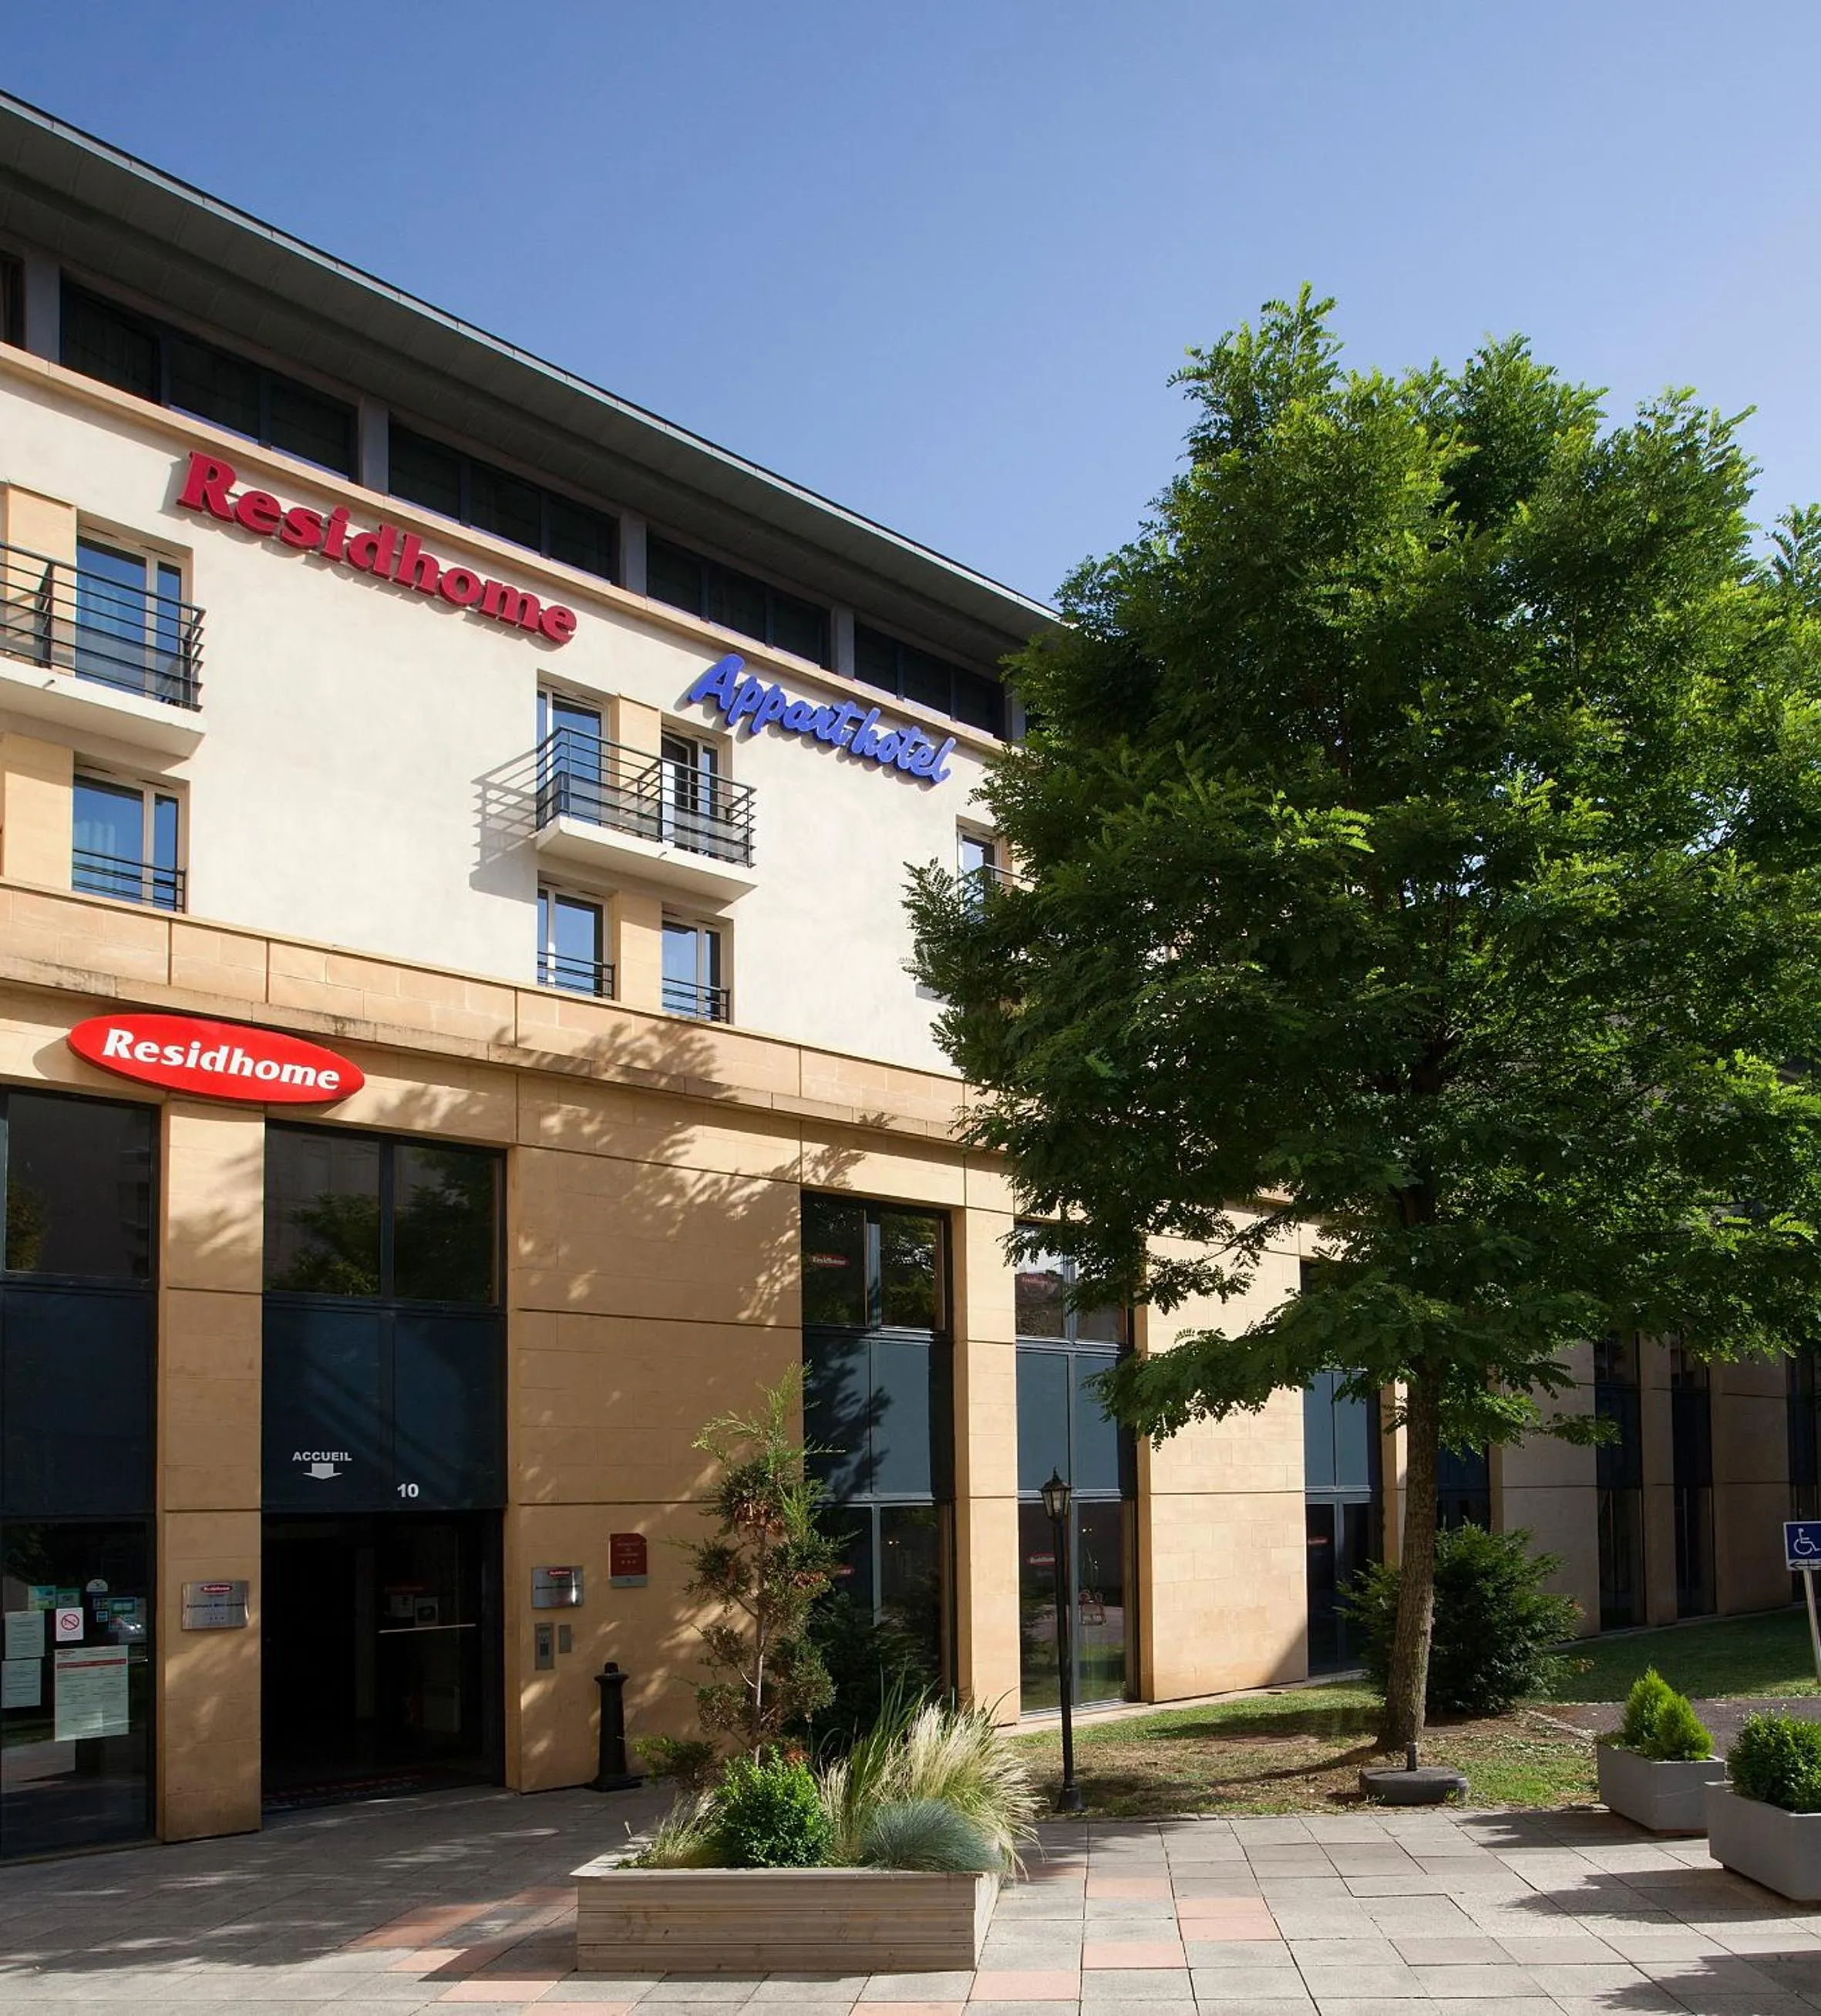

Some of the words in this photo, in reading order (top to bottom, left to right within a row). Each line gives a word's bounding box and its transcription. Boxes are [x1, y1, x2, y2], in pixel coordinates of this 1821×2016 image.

[177, 451, 577, 644] Residhome
[102, 1028, 340, 1090] Residhome
[292, 1451, 352, 1462] ACCUEIL
[397, 1483, 419, 1498] 10
